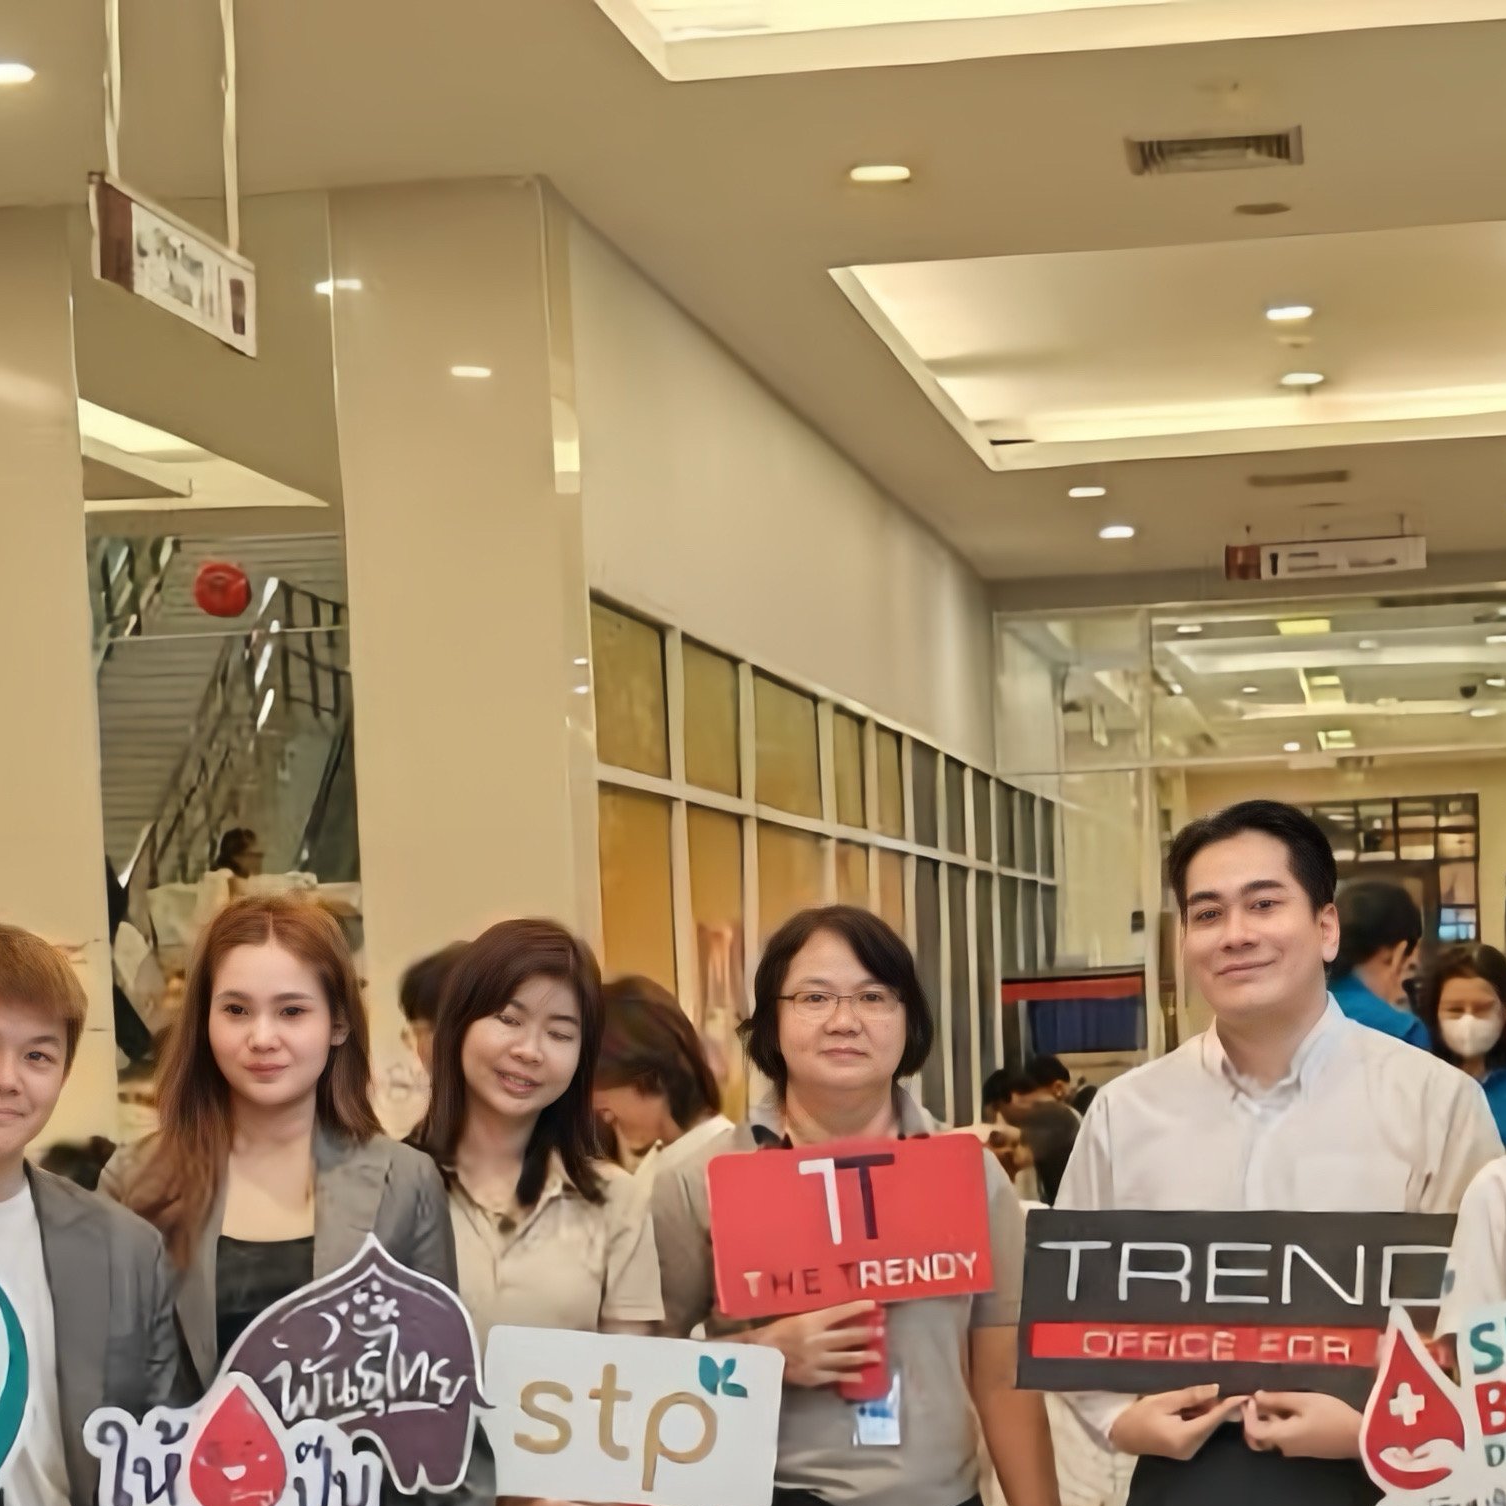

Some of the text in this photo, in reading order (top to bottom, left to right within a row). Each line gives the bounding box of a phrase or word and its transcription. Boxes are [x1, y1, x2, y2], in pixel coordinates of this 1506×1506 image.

[743, 1251, 978, 1298] THE TRENDY
[1082, 1330, 1351, 1363] OFFICE FOR
[513, 1363, 719, 1492] stp
